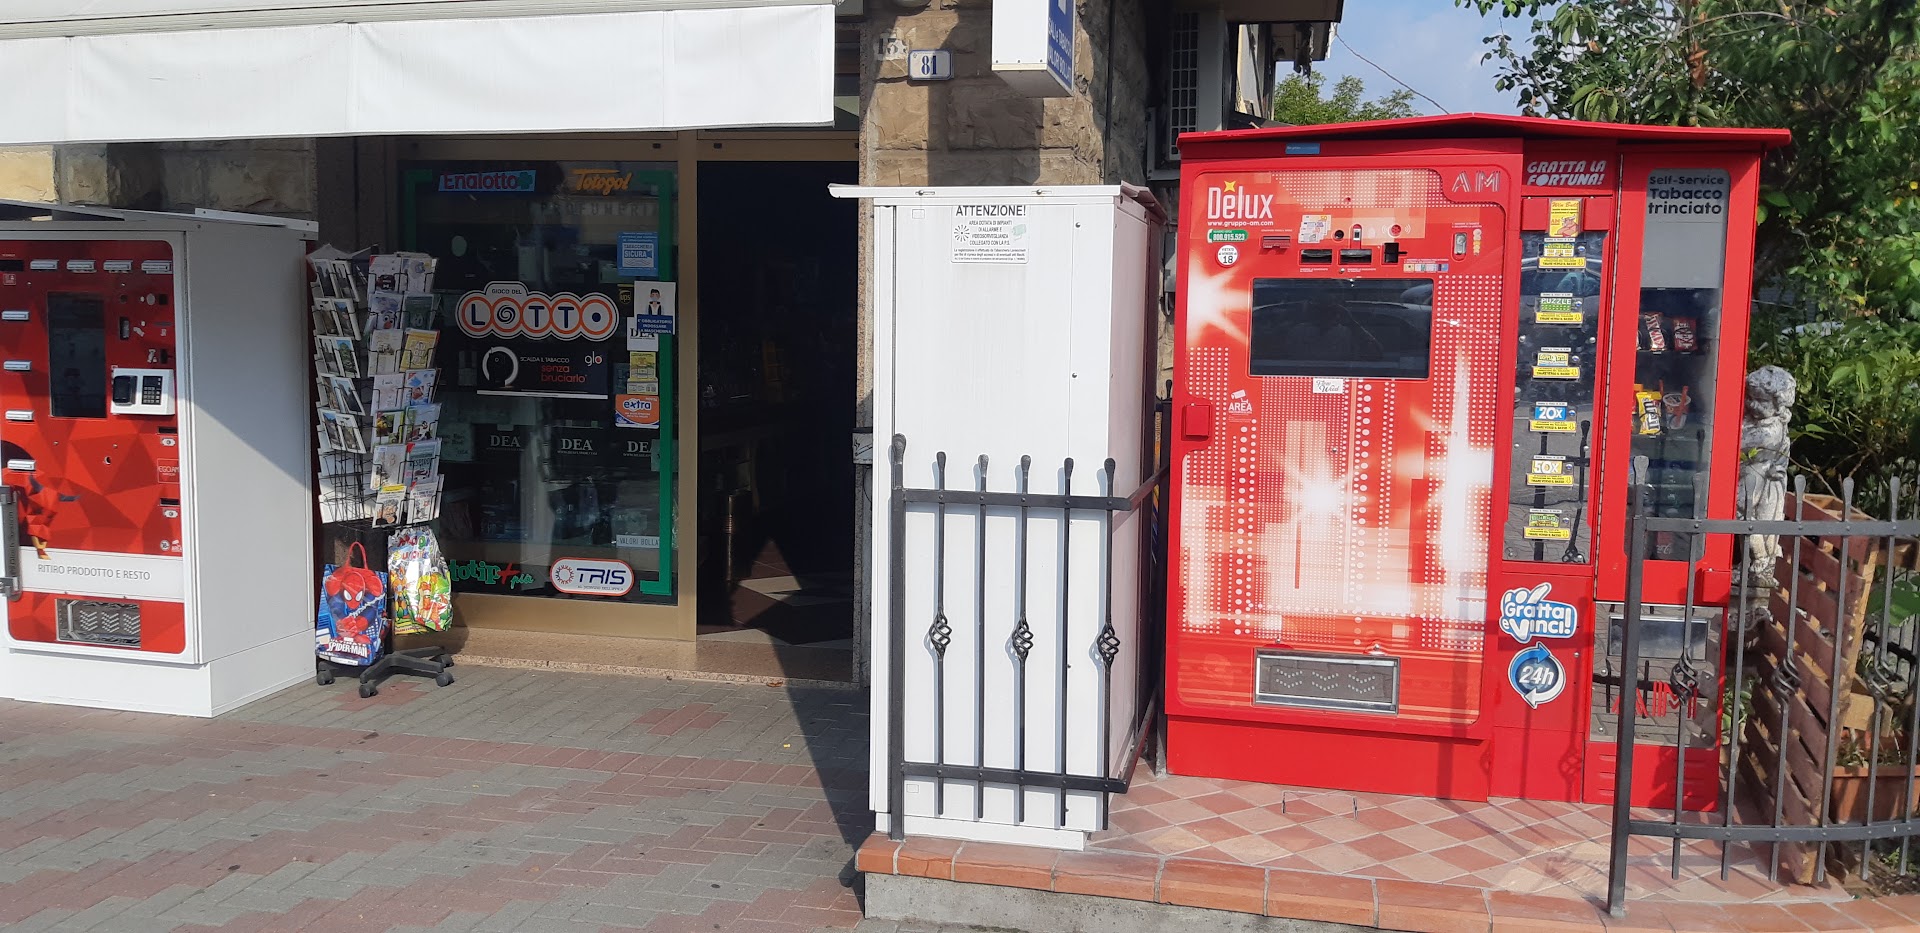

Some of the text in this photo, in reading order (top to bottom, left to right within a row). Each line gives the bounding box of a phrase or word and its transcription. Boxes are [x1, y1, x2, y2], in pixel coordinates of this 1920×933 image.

[921, 55, 937, 75] 81
[1527, 161, 1606, 173] GRATTA LA
[443, 172, 520, 190] Enalotto
[572, 169, 632, 196] Totogol
[1527, 173, 1605, 186] FORTUNA!
[1650, 176, 1724, 184] Self-Service
[1650, 187, 1722, 200] Tabacco
[1208, 185, 1274, 220] Delux
[1648, 201, 1722, 214] trinciato
[956, 205, 1026, 216] ATTENZIONE!
[624, 250, 647, 258] SICURA
[620, 294, 631, 302] ups
[467, 301, 607, 331] LOTTO
[584, 351, 602, 367] glo
[541, 365, 570, 373] senza
[541, 373, 585, 382] bruciarlo
[624, 400, 651, 410] extra
[1229, 402, 1252, 411] AREA
[490, 435, 521, 448] DEA
[560, 439, 593, 451] DEA
[627, 441, 652, 453] DE
[39, 564, 150, 580] RITIRO PRODOTTO E RESTO
[449, 560, 501, 584] totip
[576, 568, 626, 585] TRIS
[1501, 612, 1571, 641] e Vinci!
[328, 642, 368, 658] SPIDER-MAN
[1519, 666, 1555, 686] 24h
